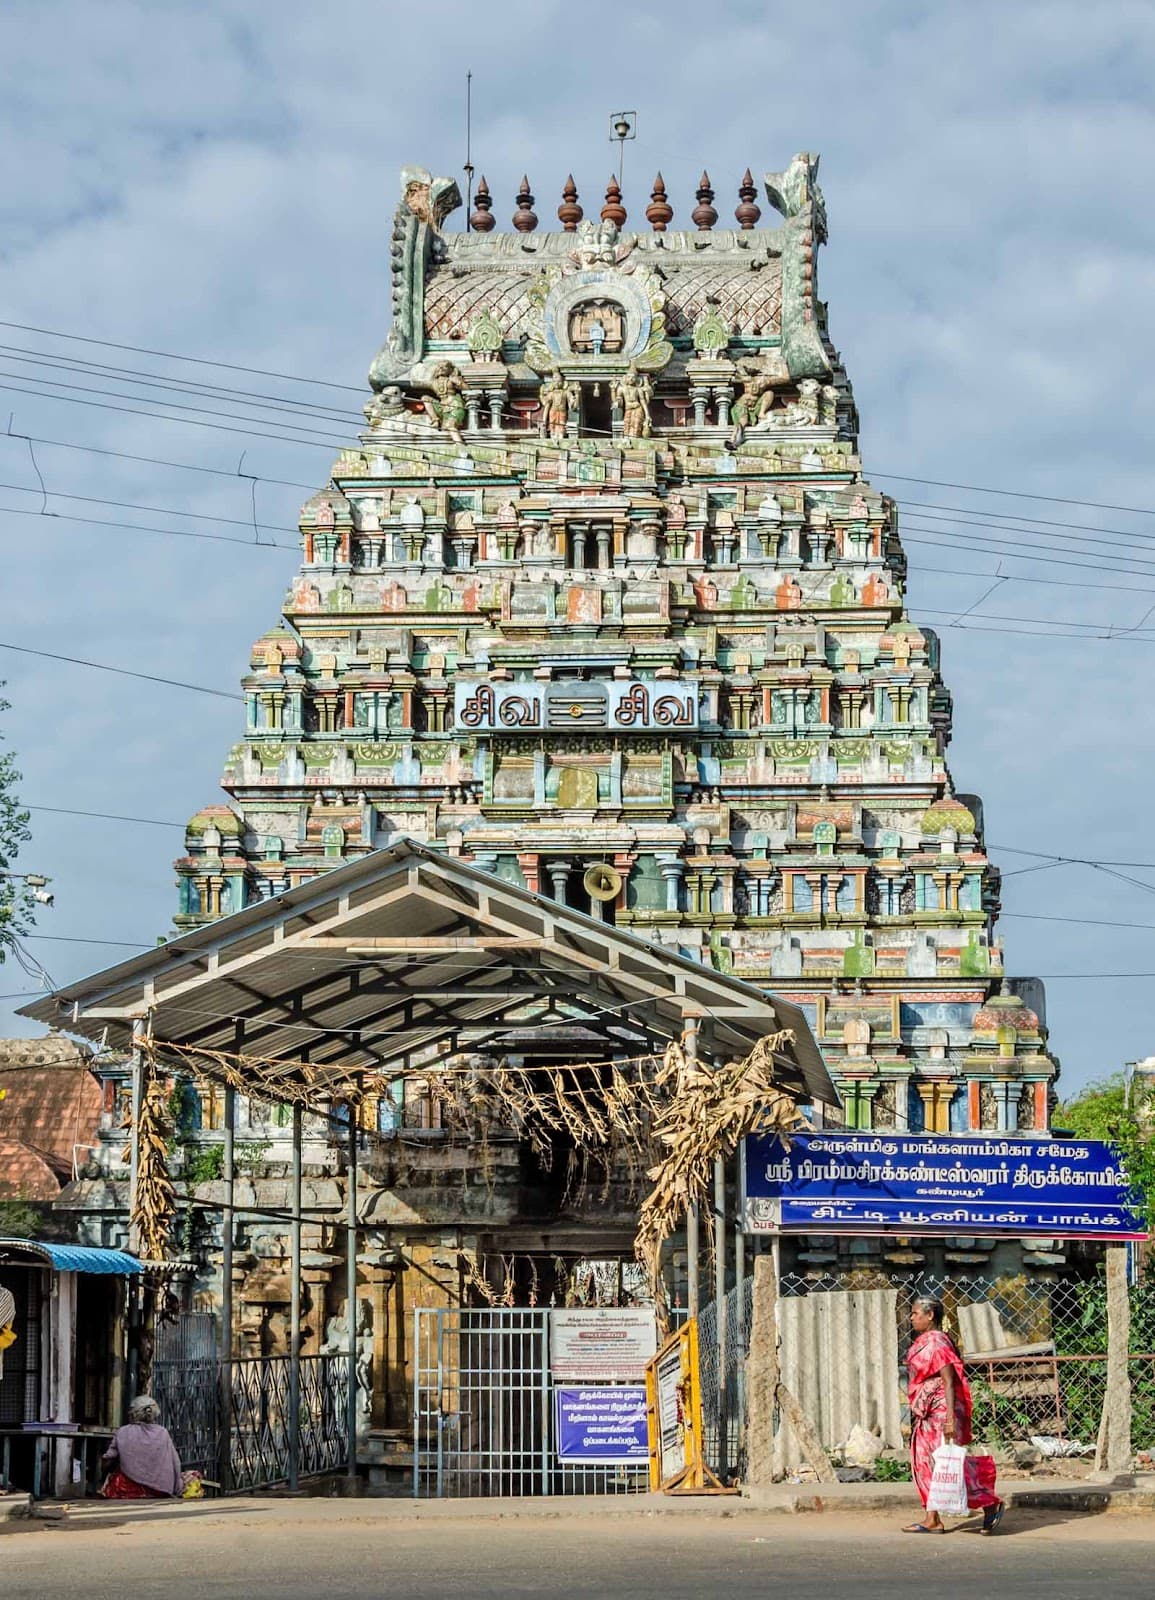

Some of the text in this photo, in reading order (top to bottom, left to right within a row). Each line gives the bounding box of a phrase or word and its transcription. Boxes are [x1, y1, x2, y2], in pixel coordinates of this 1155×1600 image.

[460, 683, 694, 727] சிவ சிவ
[808, 1138, 1090, 1161] அருள்மிகு மங்களாம்பிகா சமேத
[765, 1157, 793, 1182] ஸ்ரீ
[797, 1158, 1010, 1185] பிரம்மசிரக்கண்டீஸ்வரர்
[916, 1186, 985, 1198] கண்டியூர்
[811, 1206, 1121, 1226] சிட்டி யூனியன் பாங்க்
